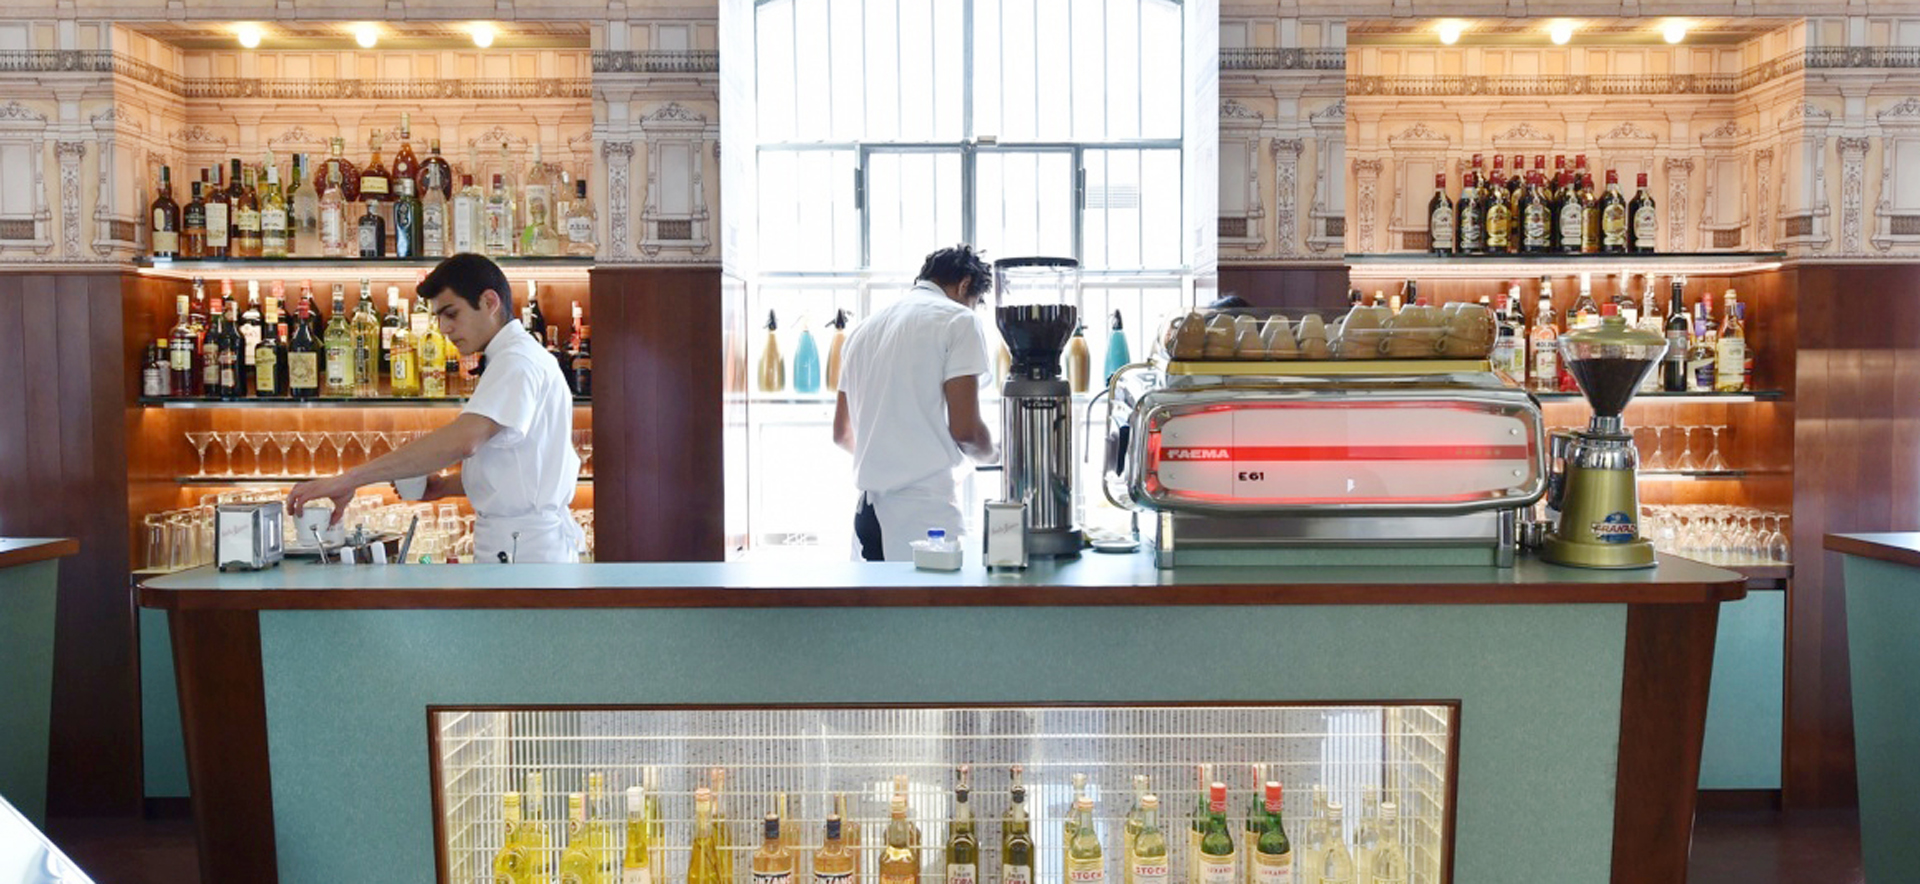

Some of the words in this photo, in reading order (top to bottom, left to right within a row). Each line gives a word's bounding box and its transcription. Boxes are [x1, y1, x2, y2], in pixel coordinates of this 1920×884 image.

[1167, 449, 1230, 459] FAEMA
[1238, 471, 1265, 481] E61
[1136, 865, 1167, 875] STOCK
[1071, 871, 1102, 880] STOCK
